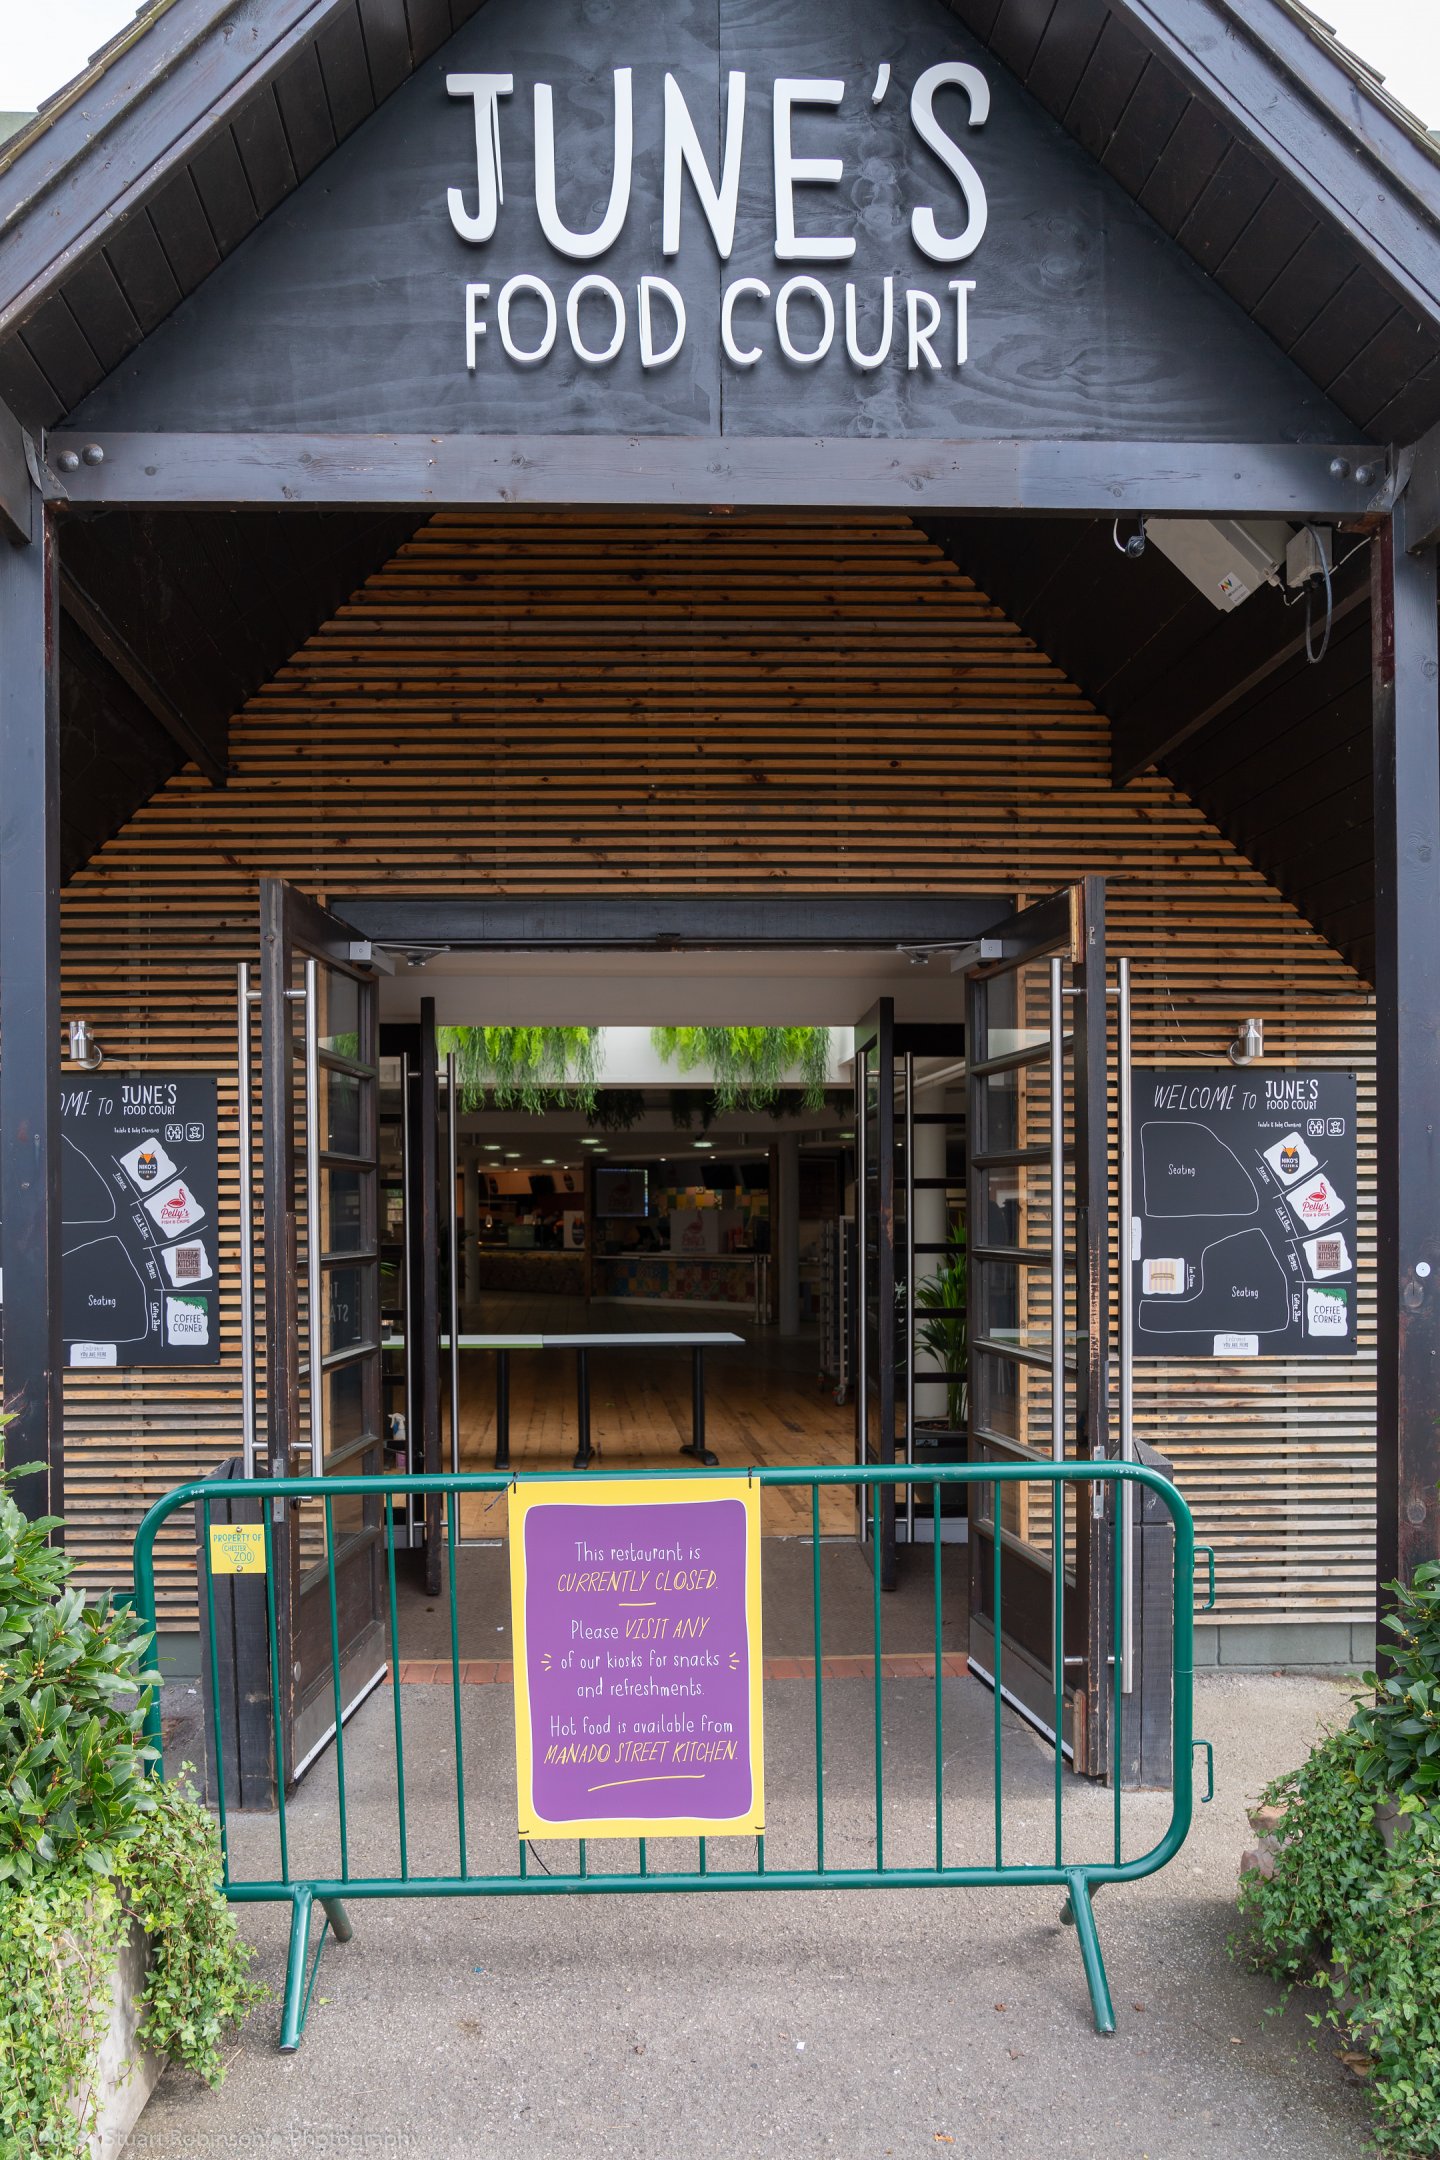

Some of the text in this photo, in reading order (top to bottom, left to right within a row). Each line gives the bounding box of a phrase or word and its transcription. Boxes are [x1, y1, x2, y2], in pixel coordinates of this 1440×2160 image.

[446, 62, 990, 262] JUNE'S
[465, 274, 977, 371] FOOD COURT
[121, 1083, 177, 1105] JUNE'S
[1153, 1084, 1257, 1111] WELCOME TO
[1265, 1079, 1319, 1100] JUNE'S
[98, 1097, 113, 1116] TO
[123, 1105, 176, 1115] FOOD COURT
[1266, 1100, 1317, 1110] FOOD COURT
[1168, 1164, 1196, 1177] Seating
[161, 1208, 189, 1219] Pelly's
[1303, 1202, 1330, 1212] Pelly's
[1231, 1286, 1259, 1299] Seating
[88, 1294, 116, 1308] Seating
[1314, 1305, 1340, 1315] COFFEE
[174, 1314, 201, 1324] COFFEE
[1313, 1314, 1341, 1324] CORNER
[173, 1323, 203, 1332] CORNER
[213, 1534, 249, 1542] PROPERTY
[234, 1552, 252, 1561] ZOO
[574, 1541, 701, 1562] This restaurant is
[557, 1569, 718, 1592] CURRENTLY CLOSED.
[571, 1617, 710, 1640] Please VISIT ANY
[561, 1650, 720, 1669] of our kiosks for snacks
[577, 1676, 705, 1698] and refreshments.
[550, 1712, 733, 1737] Hot food is available from
[544, 1740, 738, 1764] MANADO STREET KITCHEN.
